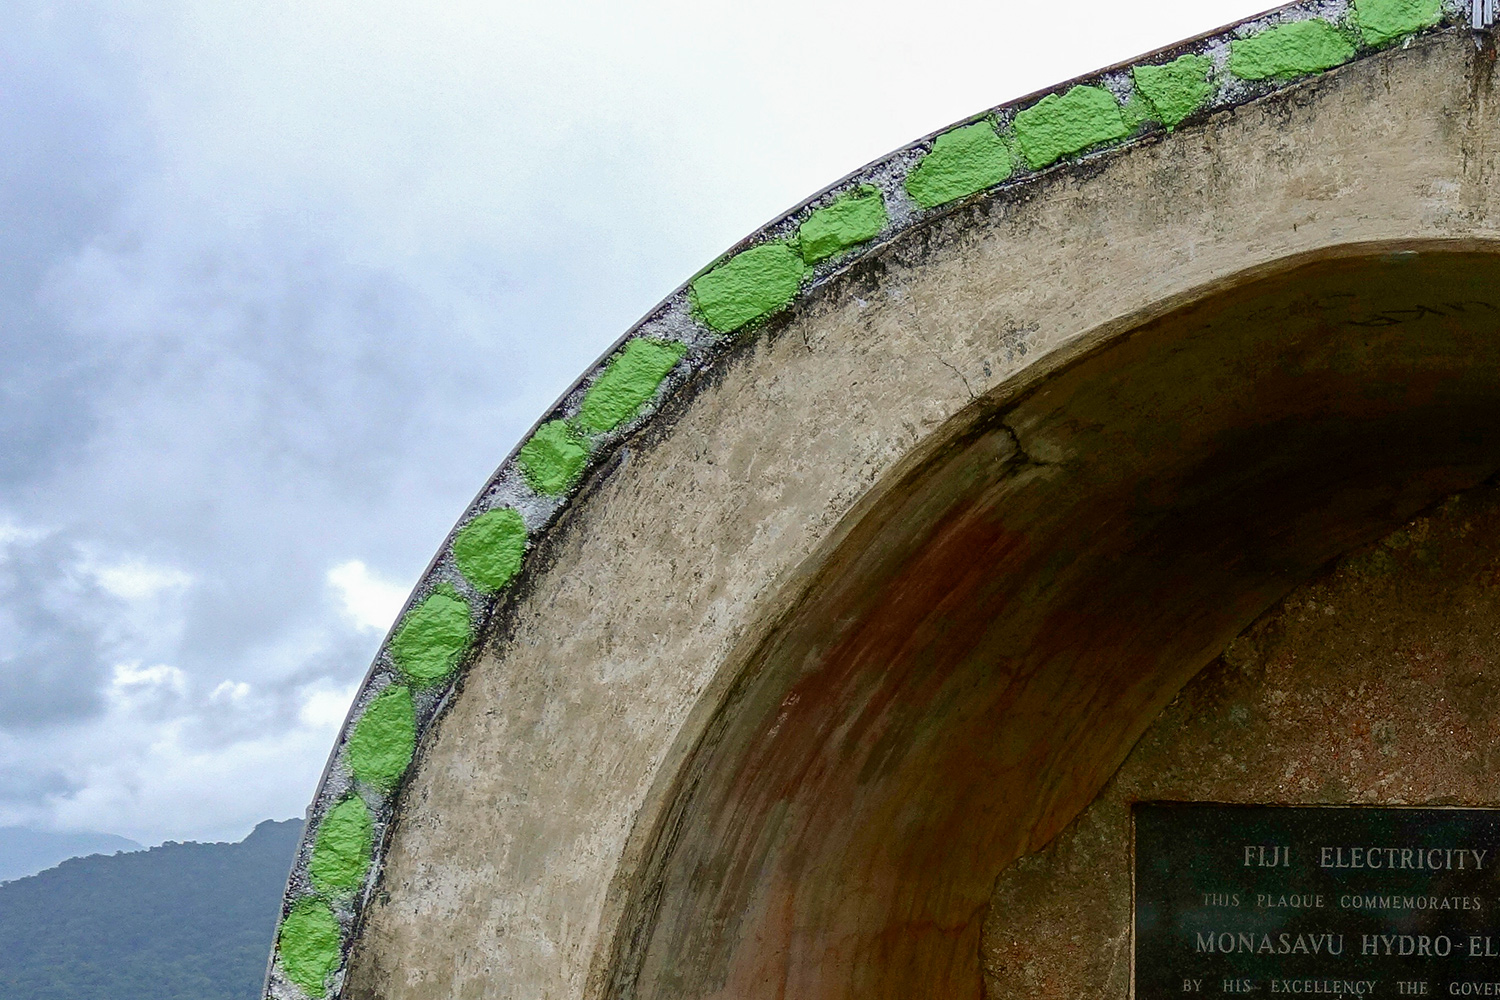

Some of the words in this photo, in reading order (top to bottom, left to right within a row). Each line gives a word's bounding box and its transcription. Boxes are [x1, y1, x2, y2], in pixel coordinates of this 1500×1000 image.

[1244, 846, 1290, 867] FIJI
[1320, 847, 1488, 870] ELECTRICITY
[1202, 893, 1240, 908] THIS
[1256, 894, 1325, 909] PLAQUE
[1340, 895, 1482, 910] COMMEMORATES
[1196, 932, 1344, 955] MONASAVU
[1183, 979, 1203, 993] BY
[1223, 979, 1251, 994] HIS
[1271, 979, 1377, 995] EXCELLENCY
[1397, 981, 1429, 995] THE
